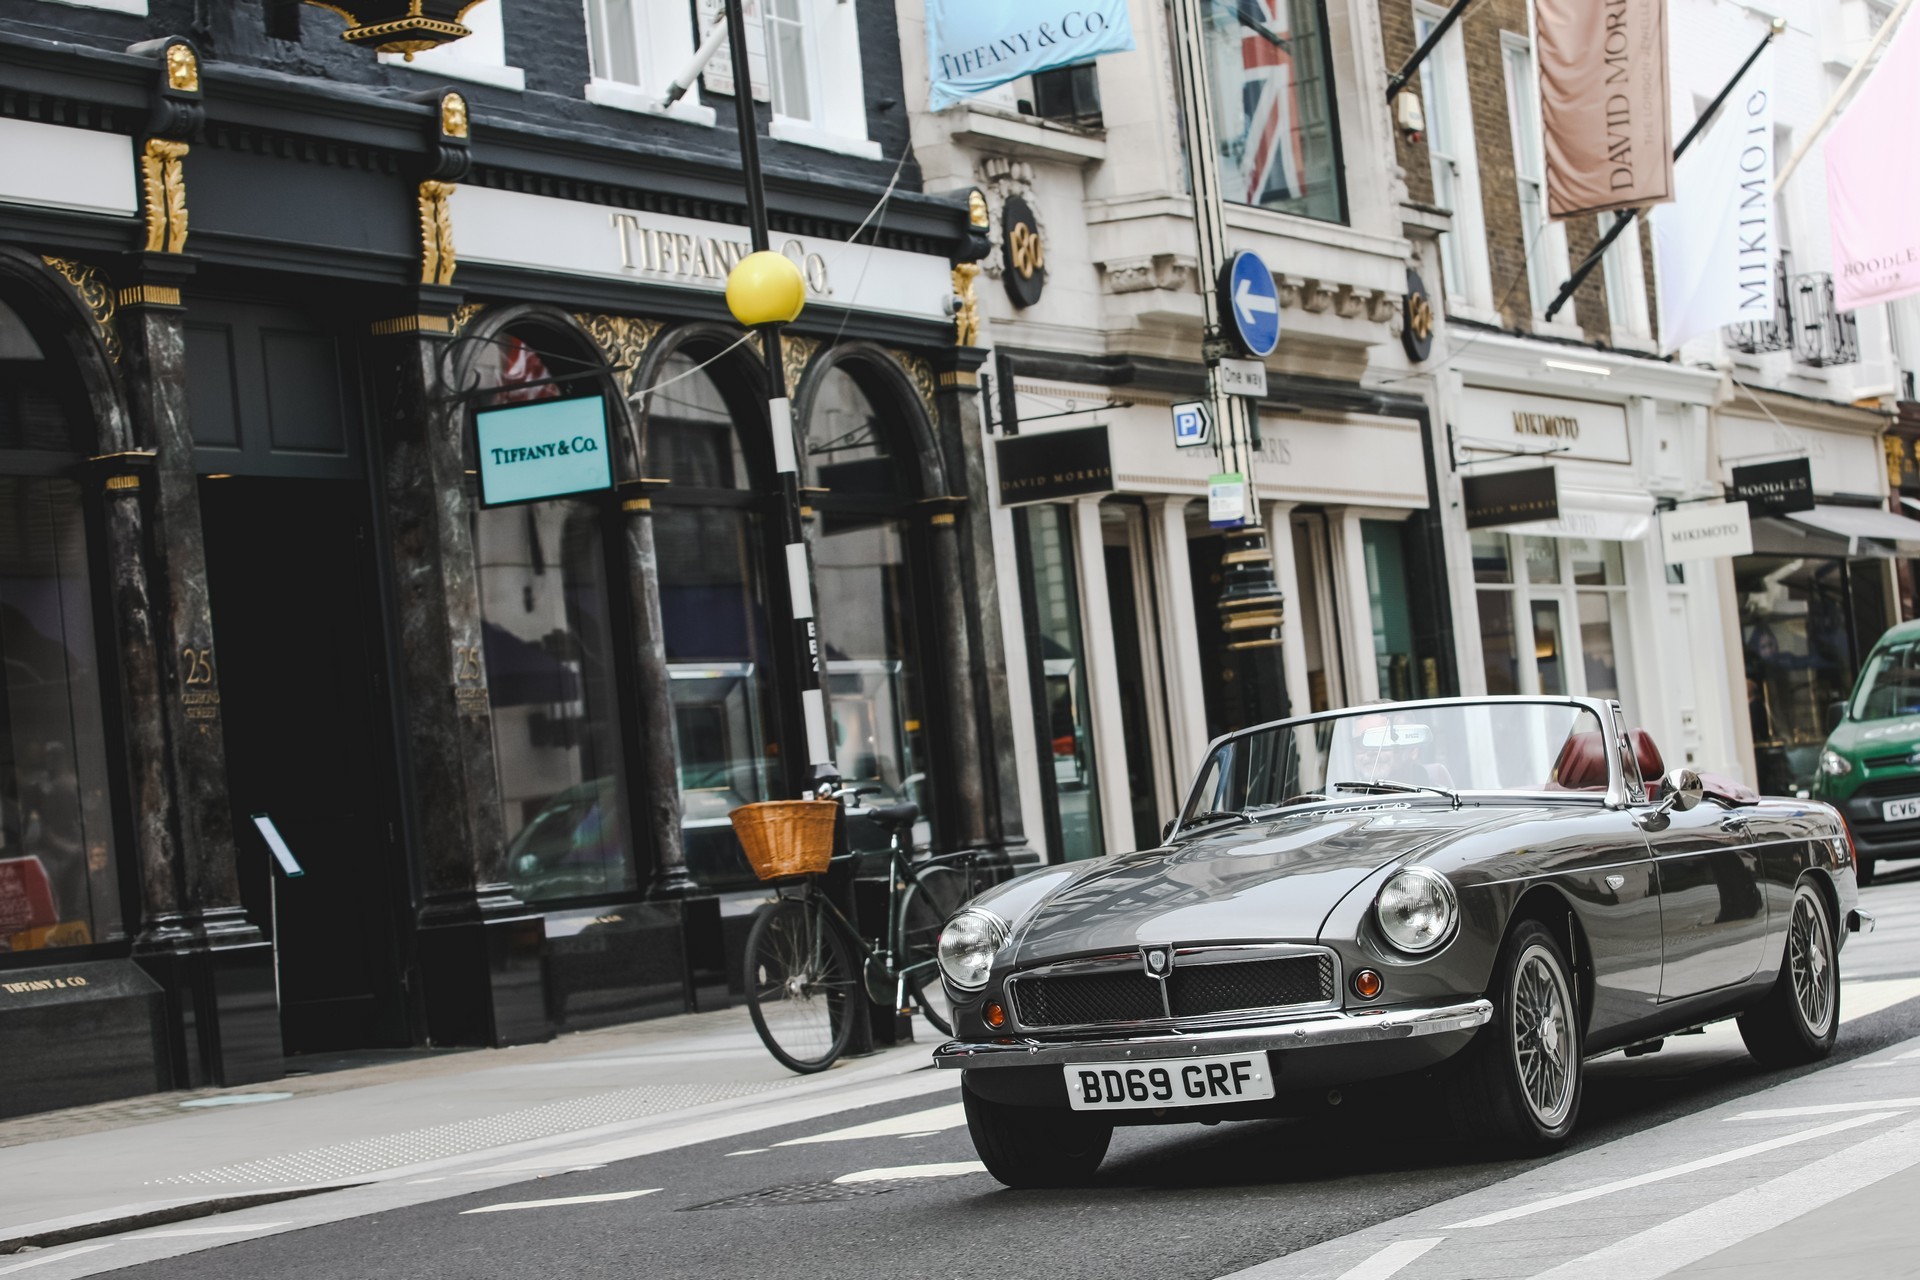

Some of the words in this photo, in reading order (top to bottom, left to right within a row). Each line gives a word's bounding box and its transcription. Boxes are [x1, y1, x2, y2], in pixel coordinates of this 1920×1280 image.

[940, 29, 1032, 80] TIFFANY
[1038, 22, 1057, 47] &
[1641, 61, 1653, 118] LONDON
[1605, 94, 1635, 192] DAVID
[1643, 119, 1654, 146] THE
[1843, 246, 1920, 278] BOODLE
[1224, 366, 1242, 384] One
[1181, 415, 1196, 435] P
[1512, 411, 1580, 440] MIKIMOTO
[491, 443, 556, 465] TIFFANY
[557, 440, 570, 456] &
[1001, 476, 1047, 491] DAVID
[1054, 467, 1111, 483] MORRIS
[1738, 476, 1808, 498] BOODLES
[1467, 505, 1505, 519] DAVID
[1671, 523, 1740, 543] MIKIMOTO
[183, 648, 212, 685] 25
[457, 646, 480, 680] 25
[1889, 801, 1920, 818] CV6
[2, 979, 54, 994] TIFFANY
[55, 978, 67, 989] &
[1078, 1068, 1173, 1103] BD69
[1181, 1060, 1252, 1099] GRF
